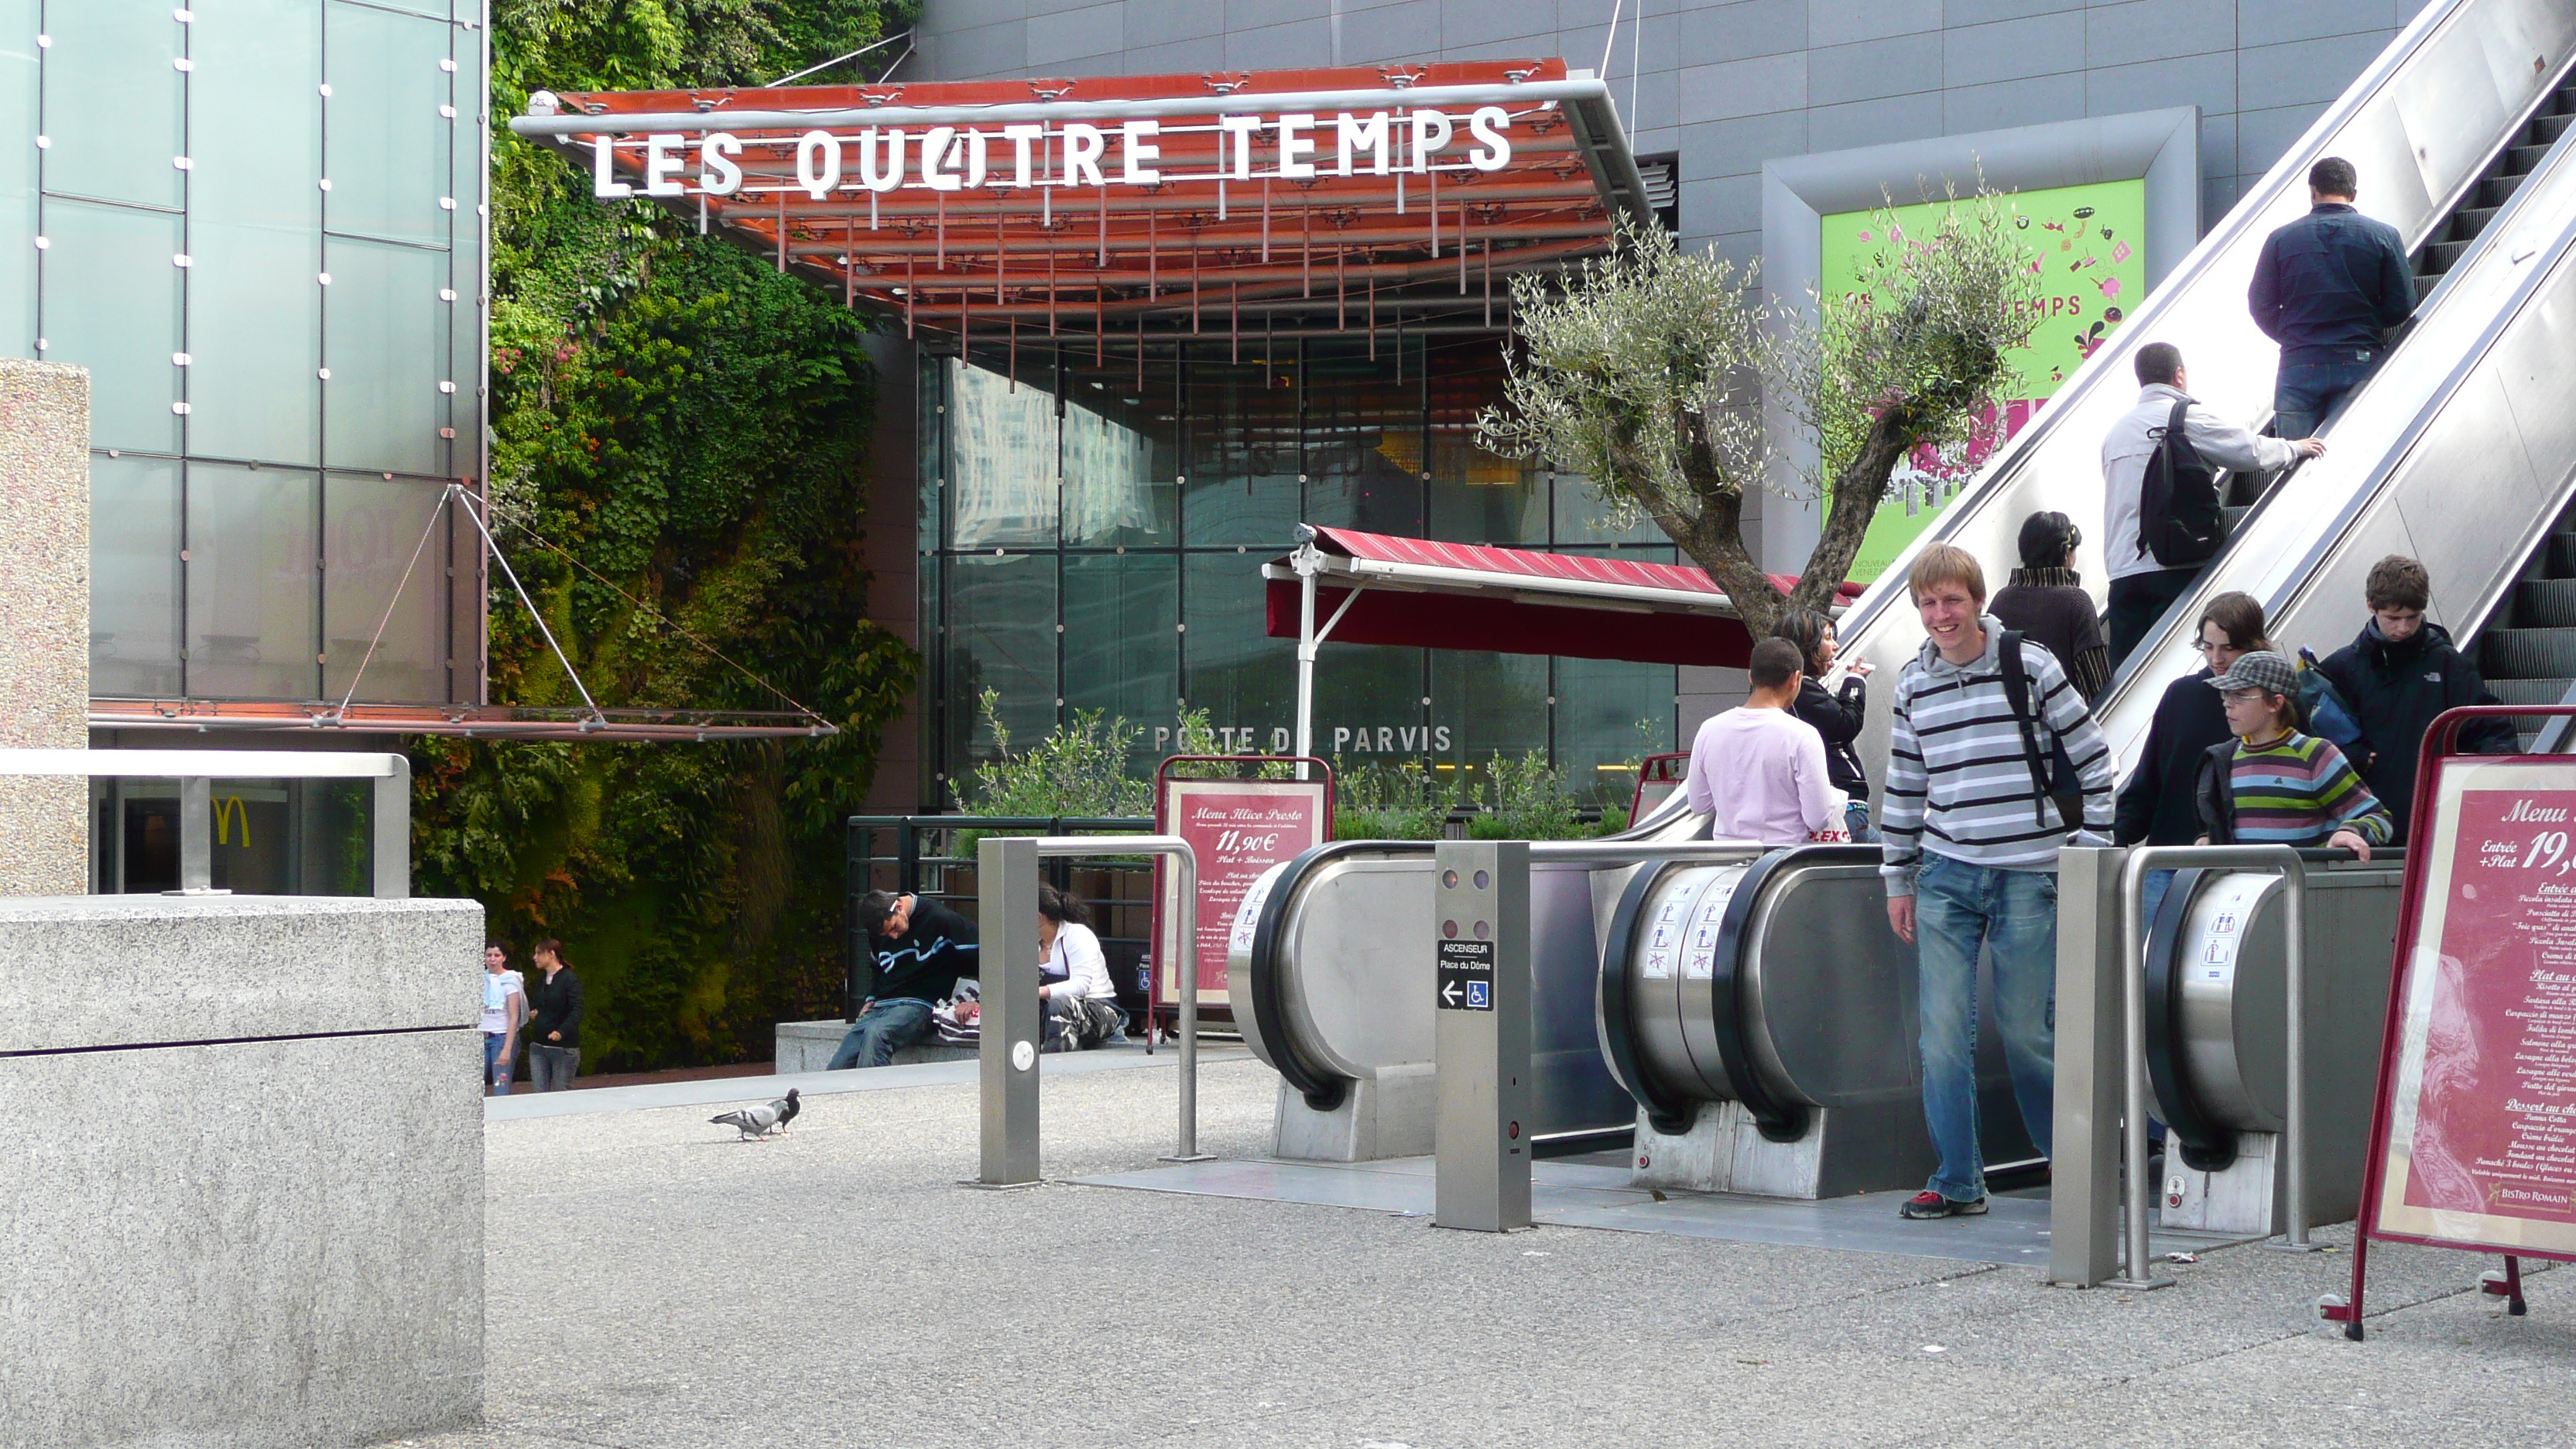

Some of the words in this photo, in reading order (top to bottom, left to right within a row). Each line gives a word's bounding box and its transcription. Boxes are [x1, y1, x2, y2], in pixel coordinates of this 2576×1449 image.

[595, 132, 742, 197] LES
[1221, 106, 1512, 182] TEMPS
[1334, 726, 1451, 752] PARVIS
[1191, 807, 1227, 820] Menu
[1229, 808, 1262, 820] Illico
[1266, 809, 1303, 820] Presto
[2501, 799, 2567, 822] Menu
[1215, 831, 1279, 855] 11,90€
[2481, 839, 2517, 852] Entrée
[2537, 882, 2568, 895] Entrée
[1444, 944, 1488, 954] ASCENSEUR
[1440, 960, 1458, 969] Place
[1470, 961, 1490, 970] Dôme
[2530, 969, 2555, 982] Plat
[2556, 974, 2571, 982] au
[2505, 1098, 2544, 1112] Dessert
[2546, 1105, 2560, 1113] au
